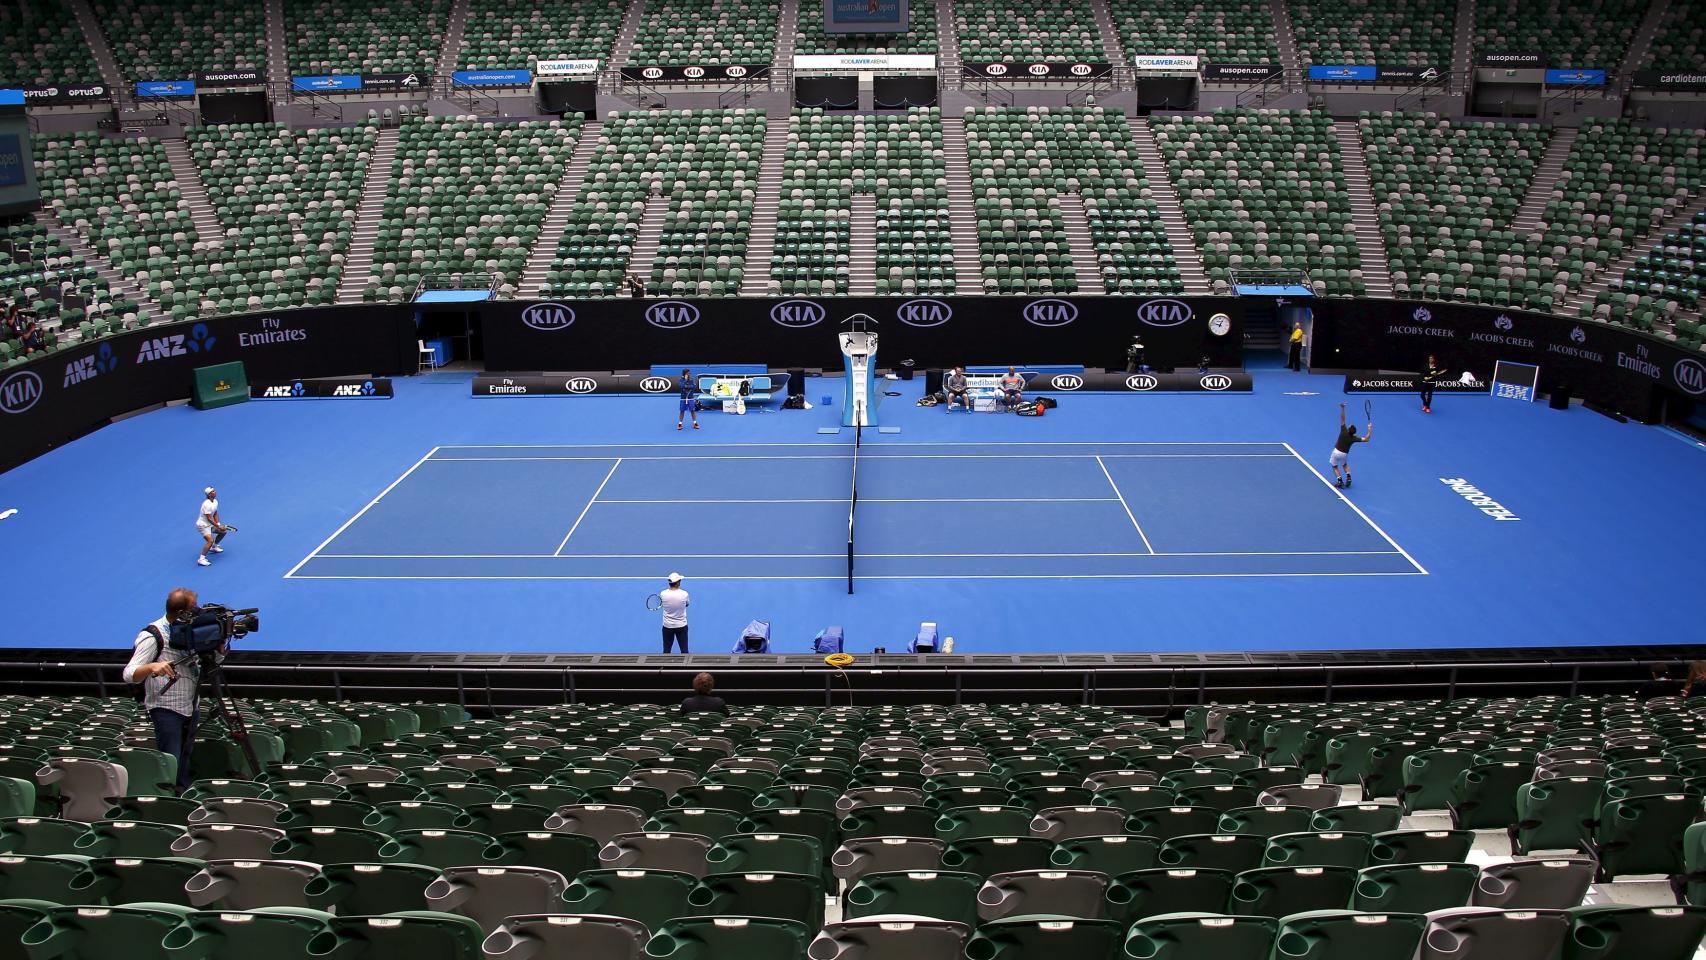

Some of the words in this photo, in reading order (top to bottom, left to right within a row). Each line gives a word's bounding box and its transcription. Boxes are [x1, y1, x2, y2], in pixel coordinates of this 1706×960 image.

[1486, 54, 1538, 62] ausopen.com
[1220, 66, 1268, 74] ausopen.com
[205, 72, 256, 81] ausopen.com
[24, 90, 48, 98] OPTUS
[68, 89, 93, 97] OPTUS
[262, 318, 280, 329] Fly
[239, 328, 307, 347] Emirates
[1425, 327, 1455, 338] CREEK
[1506, 335, 1535, 349] CREEK
[136, 334, 187, 364] ANZ
[1637, 344, 1649, 359] Fly
[1579, 349, 1603, 363] CREEK
[63, 354, 97, 389] ANZ
[1617, 352, 1661, 379] Emirates
[503, 378, 514, 386] Fly
[1390, 380, 1413, 388] CREEK
[263, 385, 292, 397] ANZ
[333, 384, 362, 396] ANZ
[489, 385, 527, 394] Emirates
[1497, 383, 1529, 401] IBM
[1439, 477, 1522, 521] MELBOURNE
